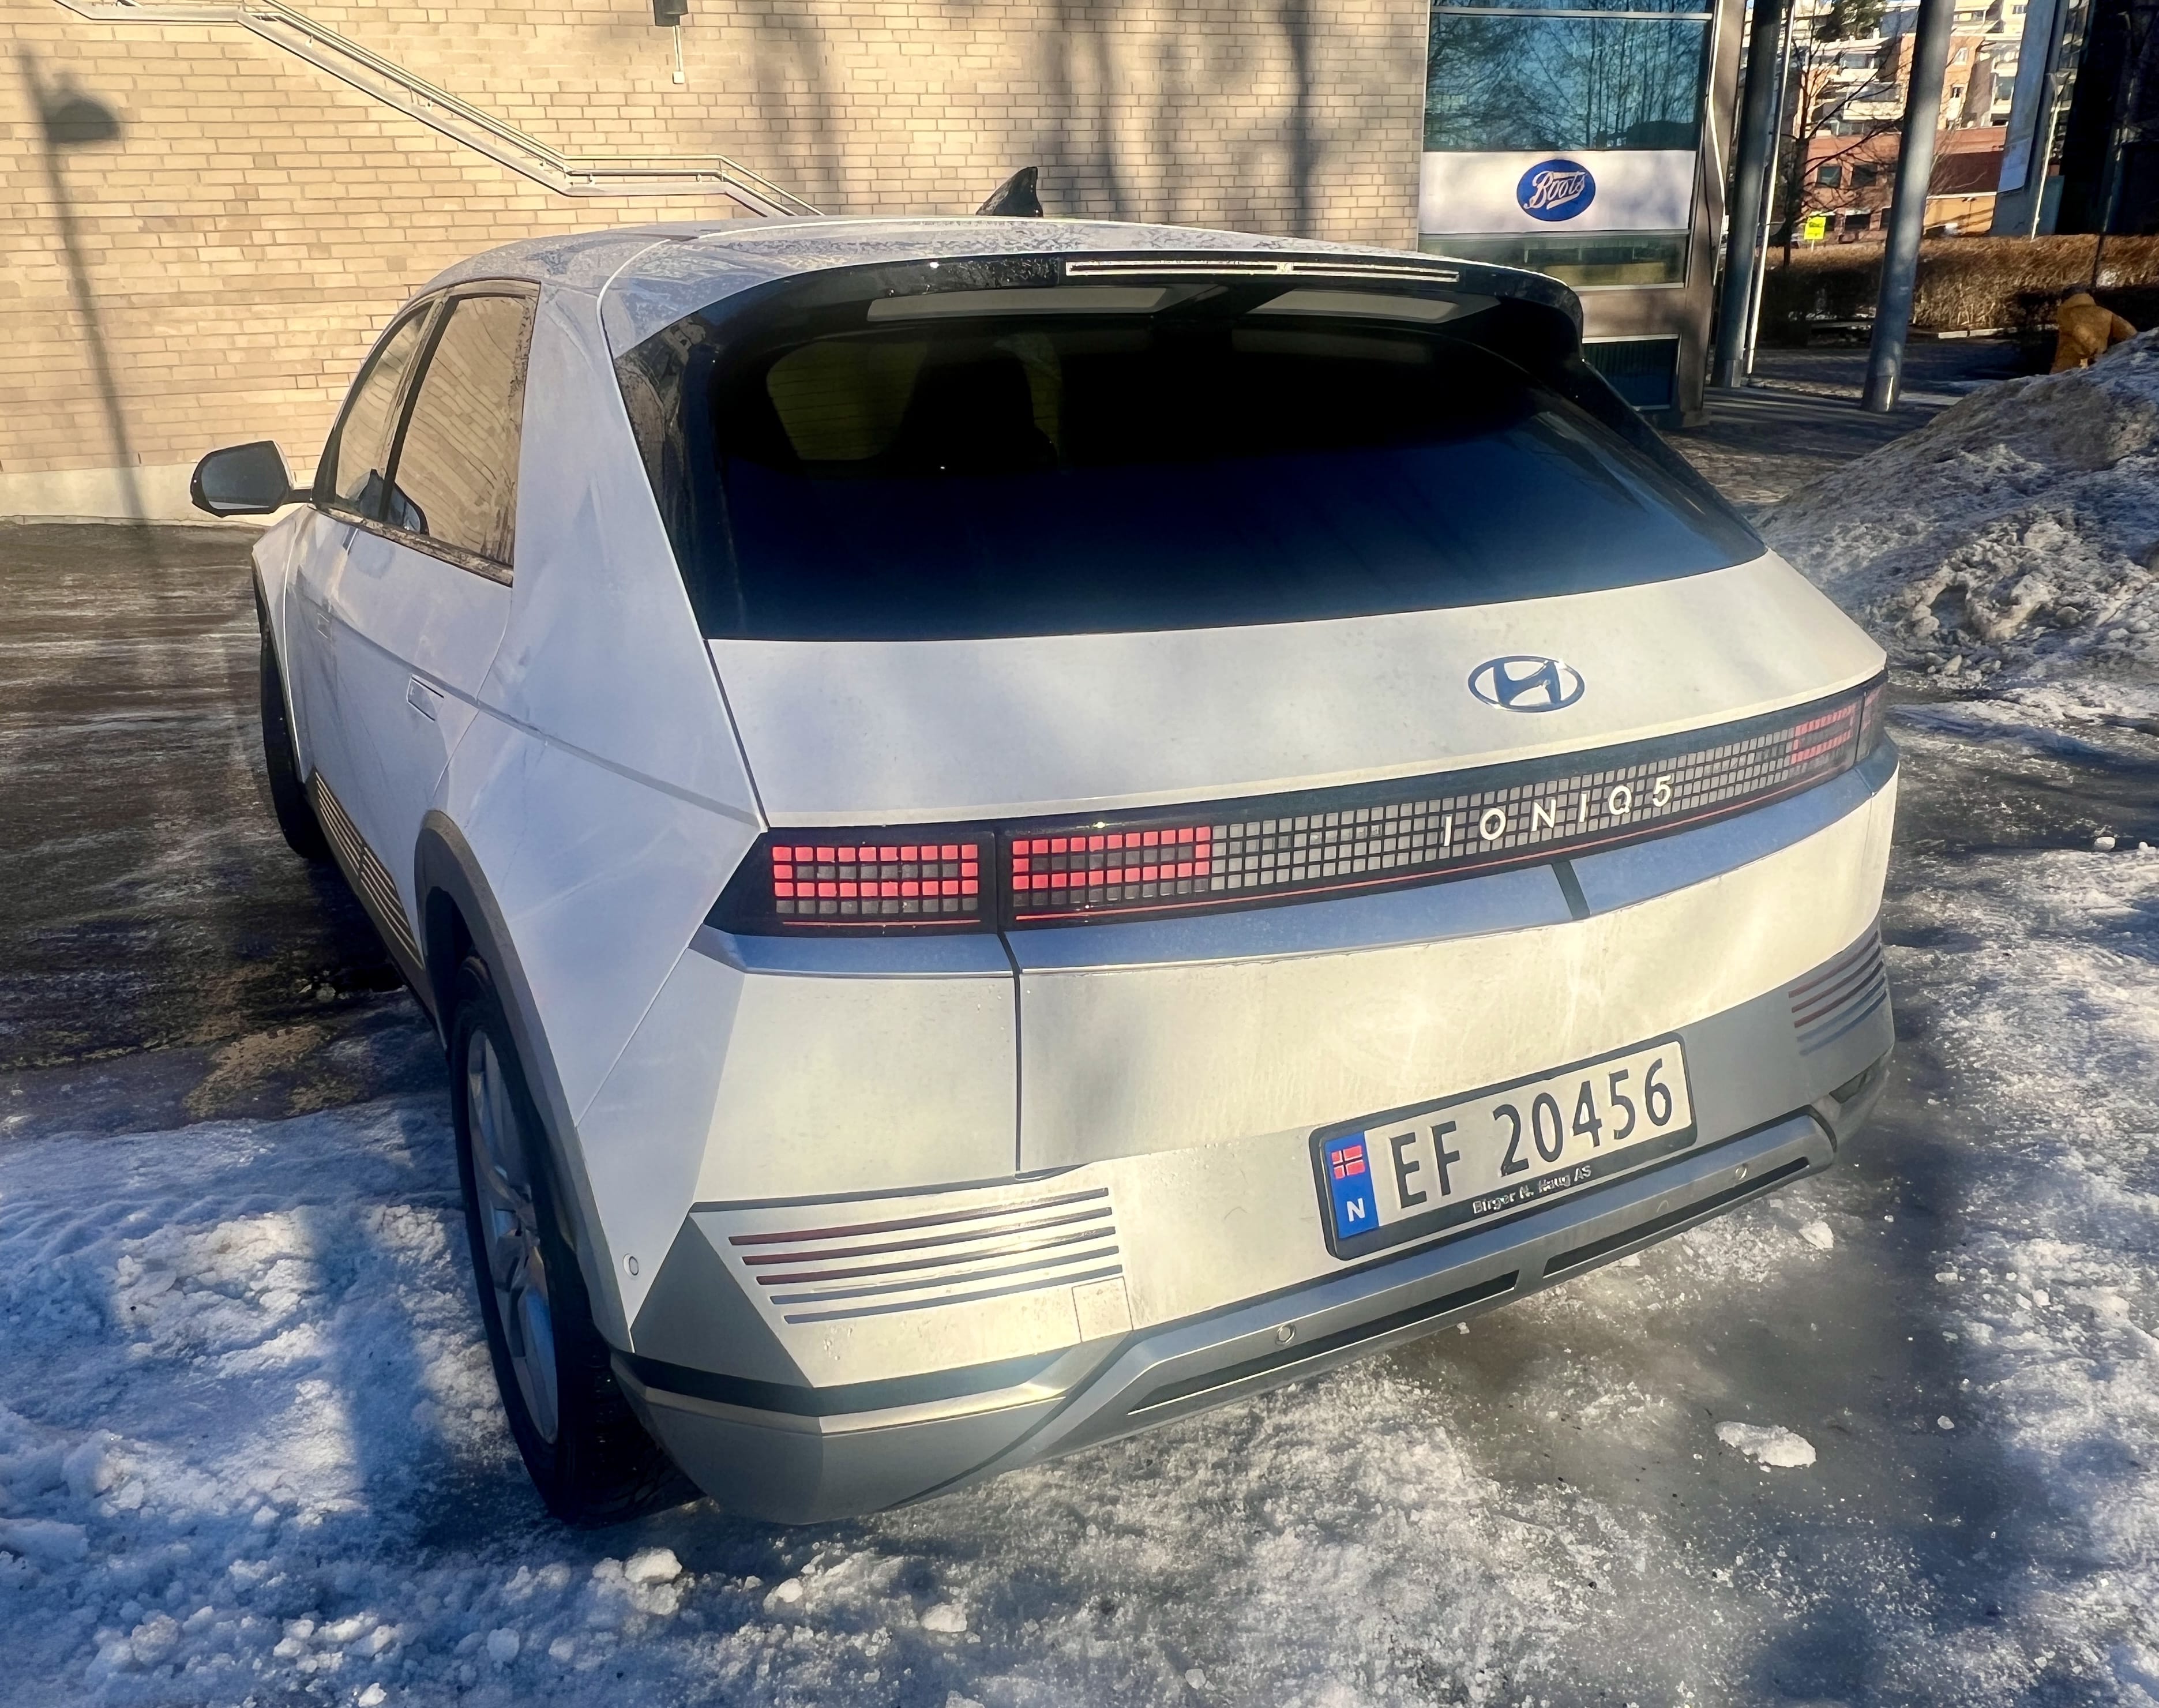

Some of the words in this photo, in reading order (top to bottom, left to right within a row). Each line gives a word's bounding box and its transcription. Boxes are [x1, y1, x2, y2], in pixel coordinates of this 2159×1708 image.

[1523, 171, 1586, 210] Boots
[1390, 1121, 1460, 1208] EF
[1492, 1058, 1673, 1178] 20456
[1574, 1165, 1592, 1182] AS
[1347, 1198, 1366, 1222] N
